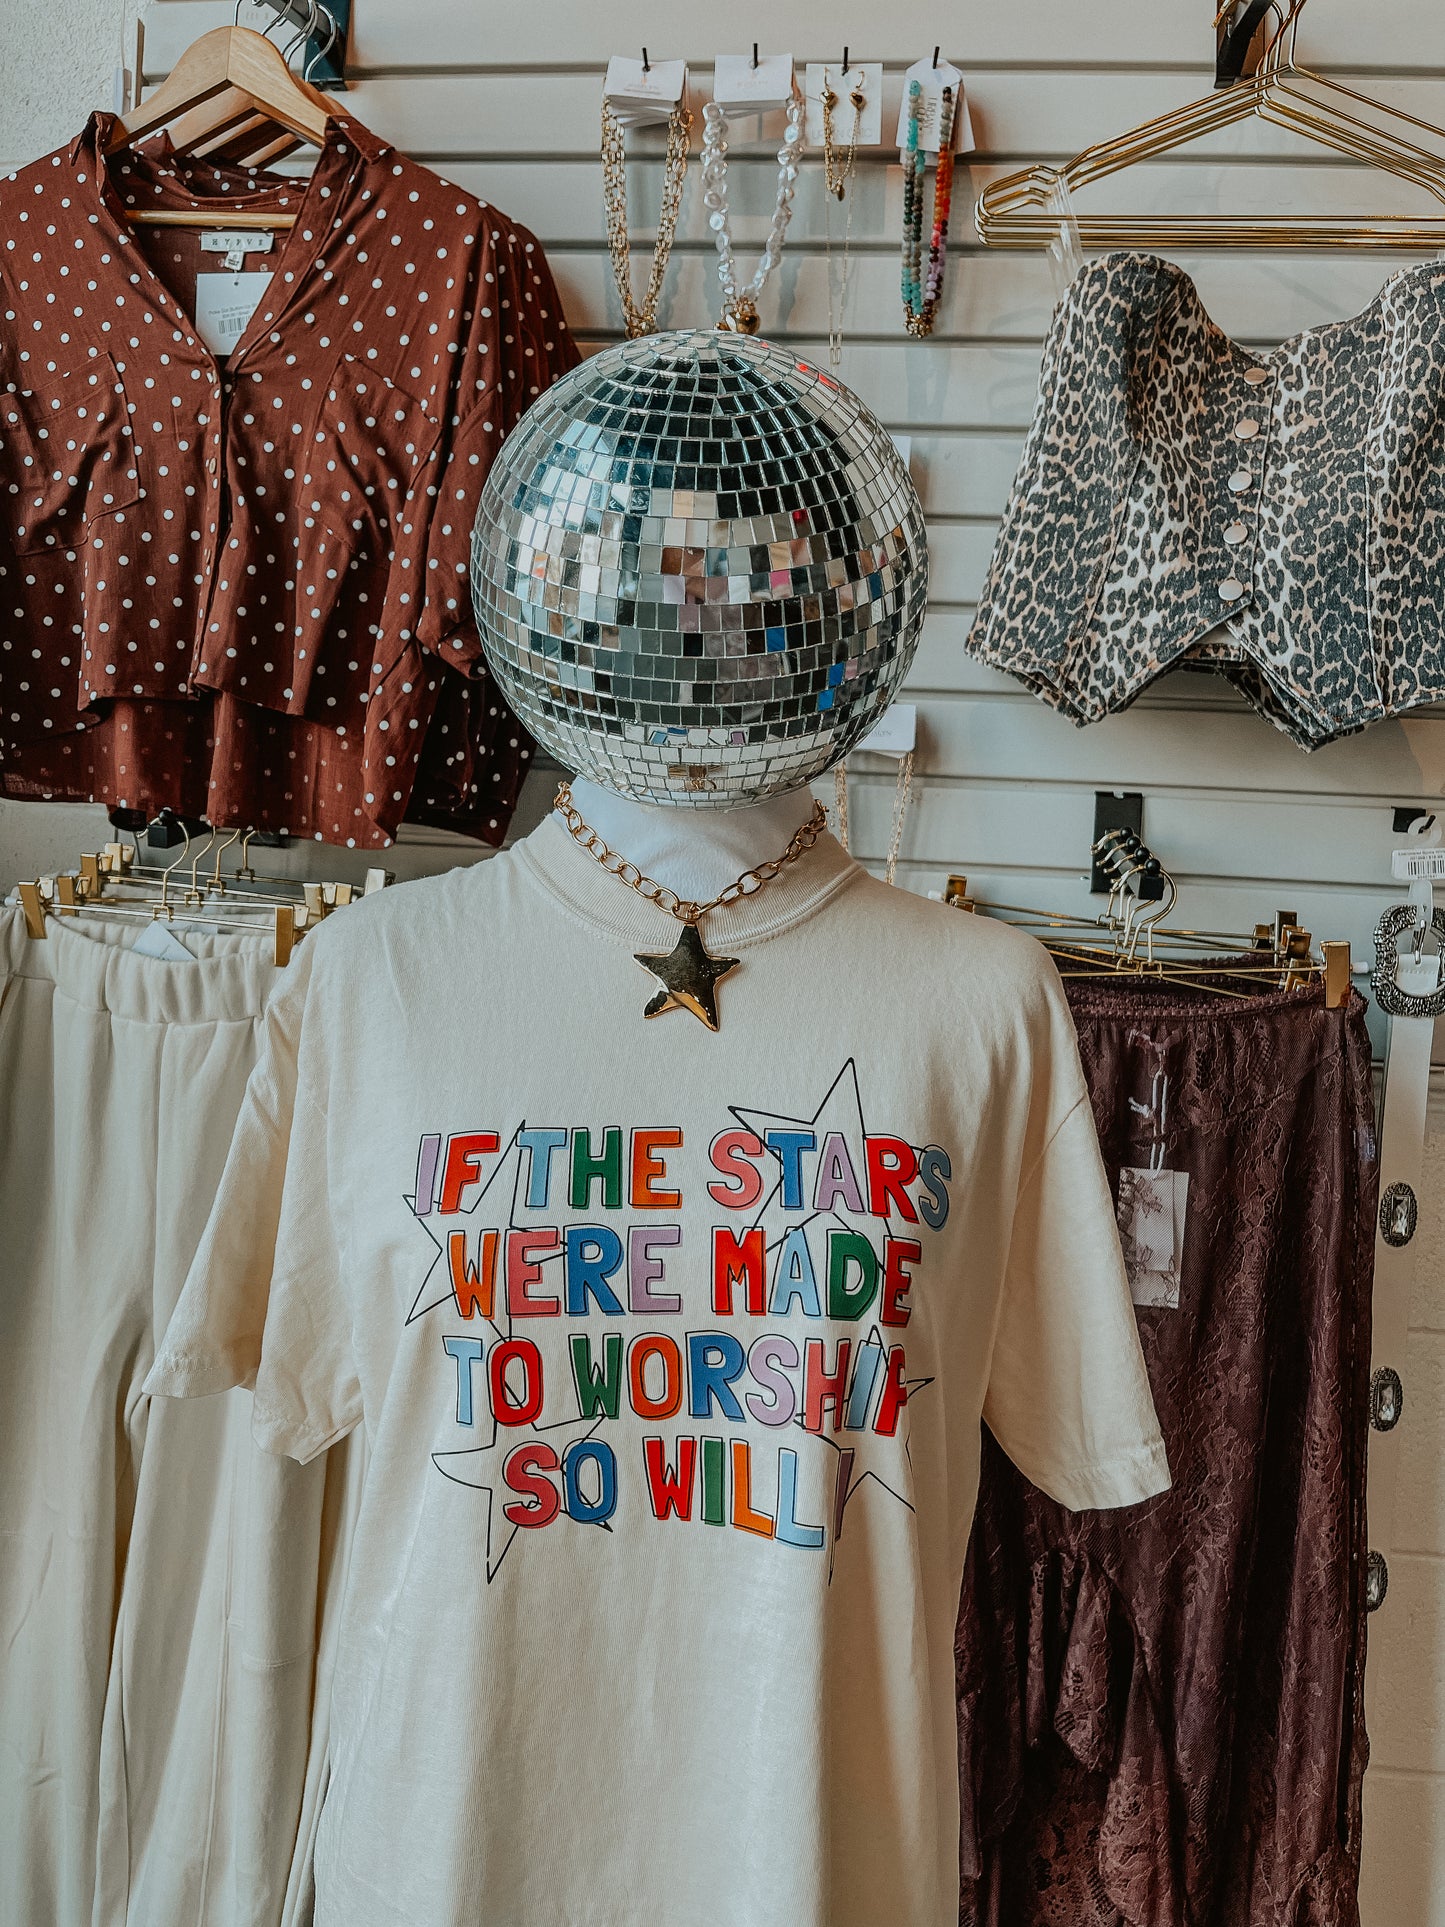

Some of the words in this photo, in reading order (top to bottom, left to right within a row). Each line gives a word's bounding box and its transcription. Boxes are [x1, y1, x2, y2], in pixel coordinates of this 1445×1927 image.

[415, 1130, 500, 1215] IF
[516, 1126, 683, 1209] THE
[706, 1127, 952, 1231] STARS
[447, 1224, 683, 1320] WERE
[711, 1225, 922, 1328] MADE
[443, 1335, 544, 1427] TO
[502, 1438, 618, 1530] SO
[642, 1435, 826, 1550] WILL
